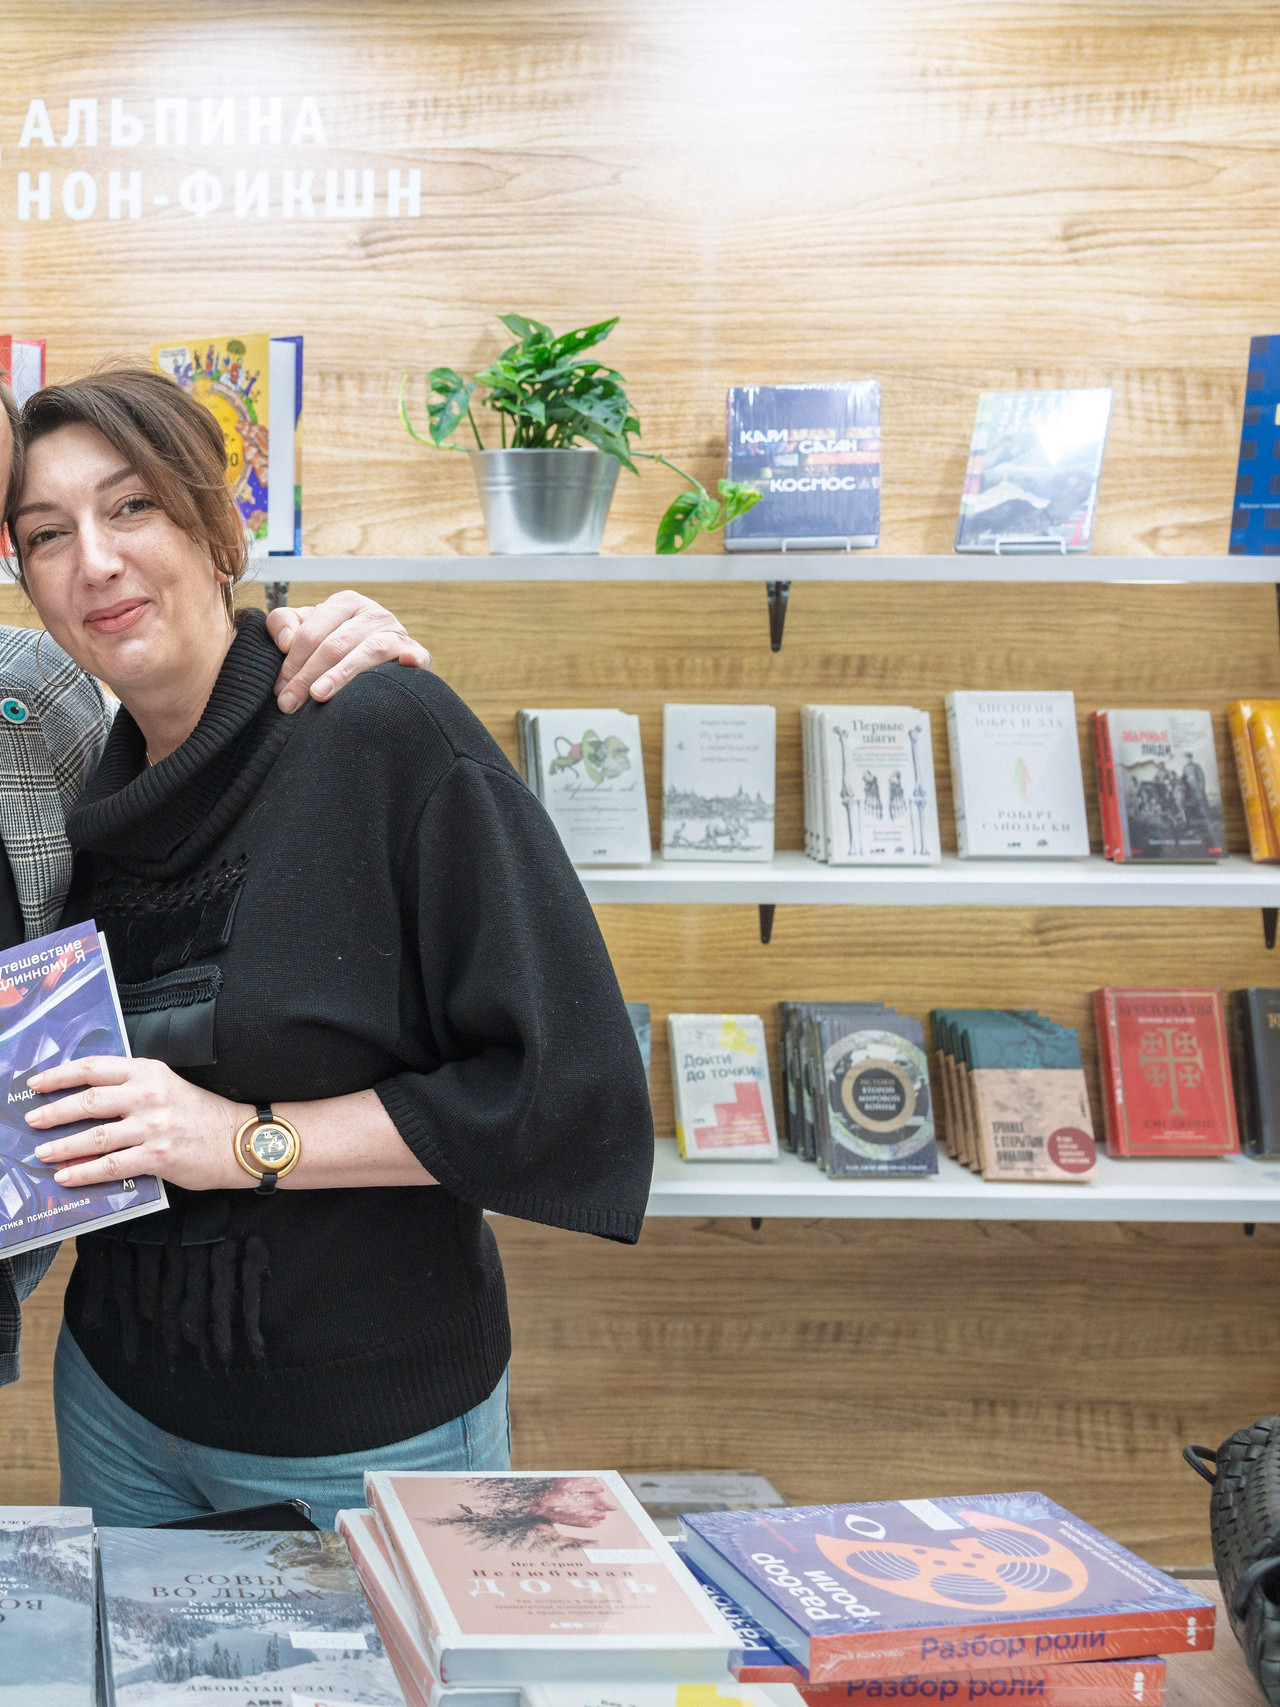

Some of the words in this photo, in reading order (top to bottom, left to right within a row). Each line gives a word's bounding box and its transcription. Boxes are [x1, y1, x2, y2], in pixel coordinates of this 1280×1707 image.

[17, 97, 328, 148] АЛЬПИНА
[17, 168, 422, 220] НОН-ФИКШН
[770, 476, 857, 493] КОСМОС
[74, 949, 87, 965] Я
[26, 1196, 91, 1224] психоанализа
[183, 1574, 286, 1586] СОВЫ
[471, 1569, 635, 1578] Нелюбимая
[151, 1586, 197, 1598] ВО
[211, 1587, 325, 1601] ЛЬДАХ
[468, 1578, 658, 1598] ДОЧЬ
[803, 1570, 882, 1619] роли
[170, 1607, 228, 1615] САМОГО
[920, 1633, 1027, 1661] Разбор
[1033, 1630, 1106, 1656] роли
[186, 1684, 285, 1692] ДЖОНАТАН
[800, 1683, 830, 1693] ухарь
[847, 1675, 958, 1699] Разбор
[968, 1674, 1045, 1701] роли
